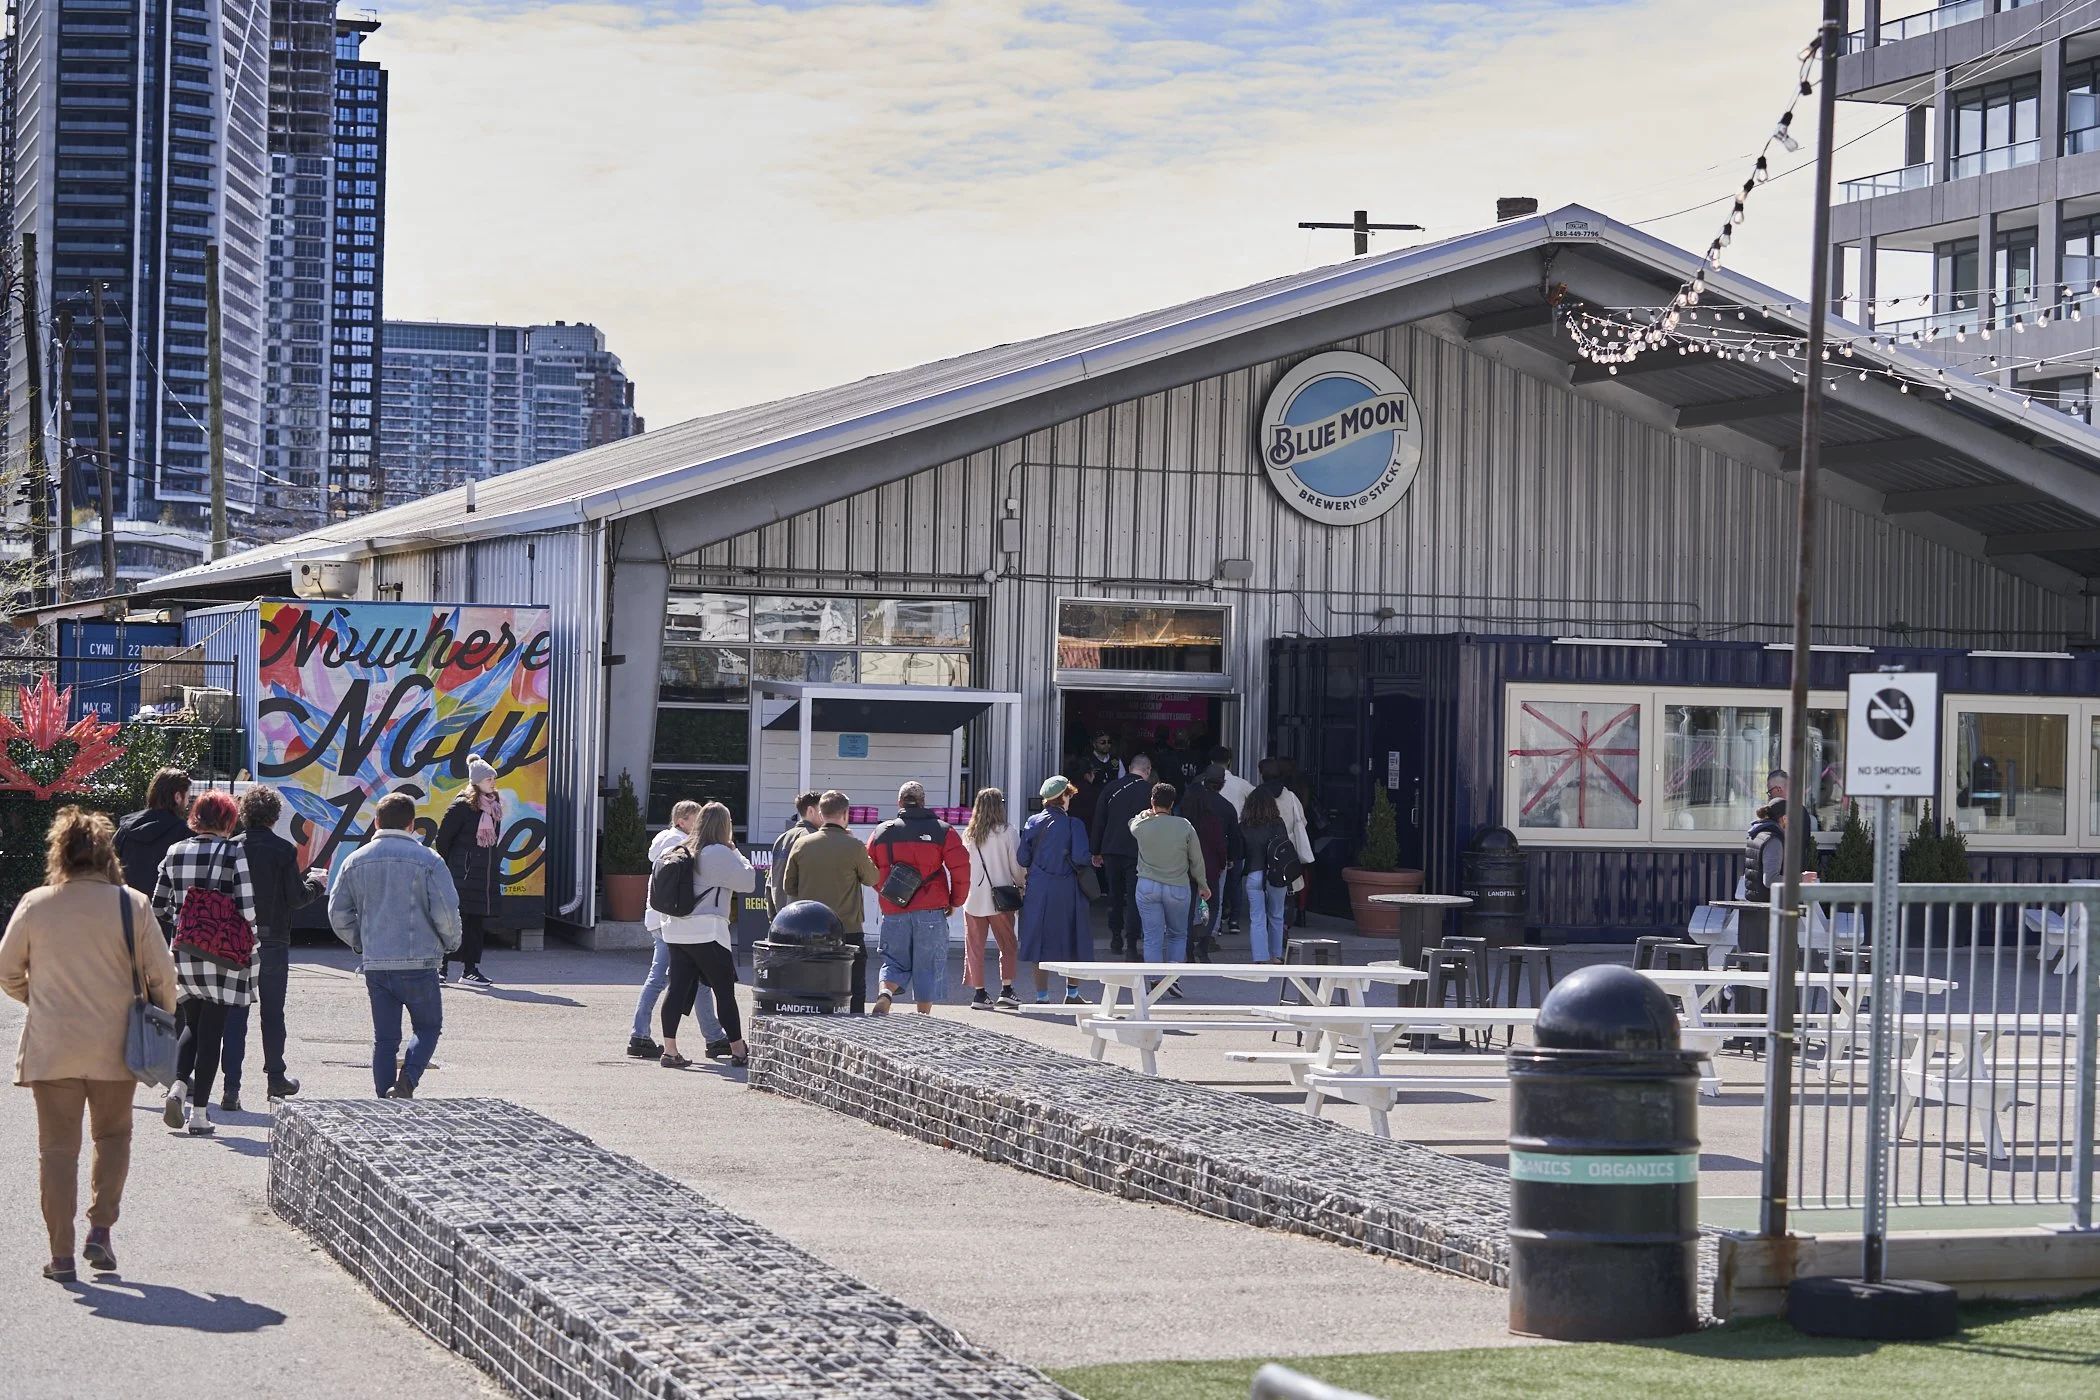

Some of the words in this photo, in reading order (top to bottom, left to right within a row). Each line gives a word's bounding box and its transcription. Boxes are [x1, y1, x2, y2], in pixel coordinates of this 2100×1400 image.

[1270, 421, 1336, 465] BLUE
[1341, 400, 1404, 440] MOON
[260, 607, 550, 671] Nowhere
[90, 643, 114, 656] CYMU
[258, 674, 550, 779] Now
[1858, 766, 1871, 776] NO
[1873, 766, 1922, 776] SMOKING
[745, 897, 768, 910] REGIS
[776, 1003, 821, 1014] LANDFILL
[1588, 1162, 1675, 1178] ORGANICS
